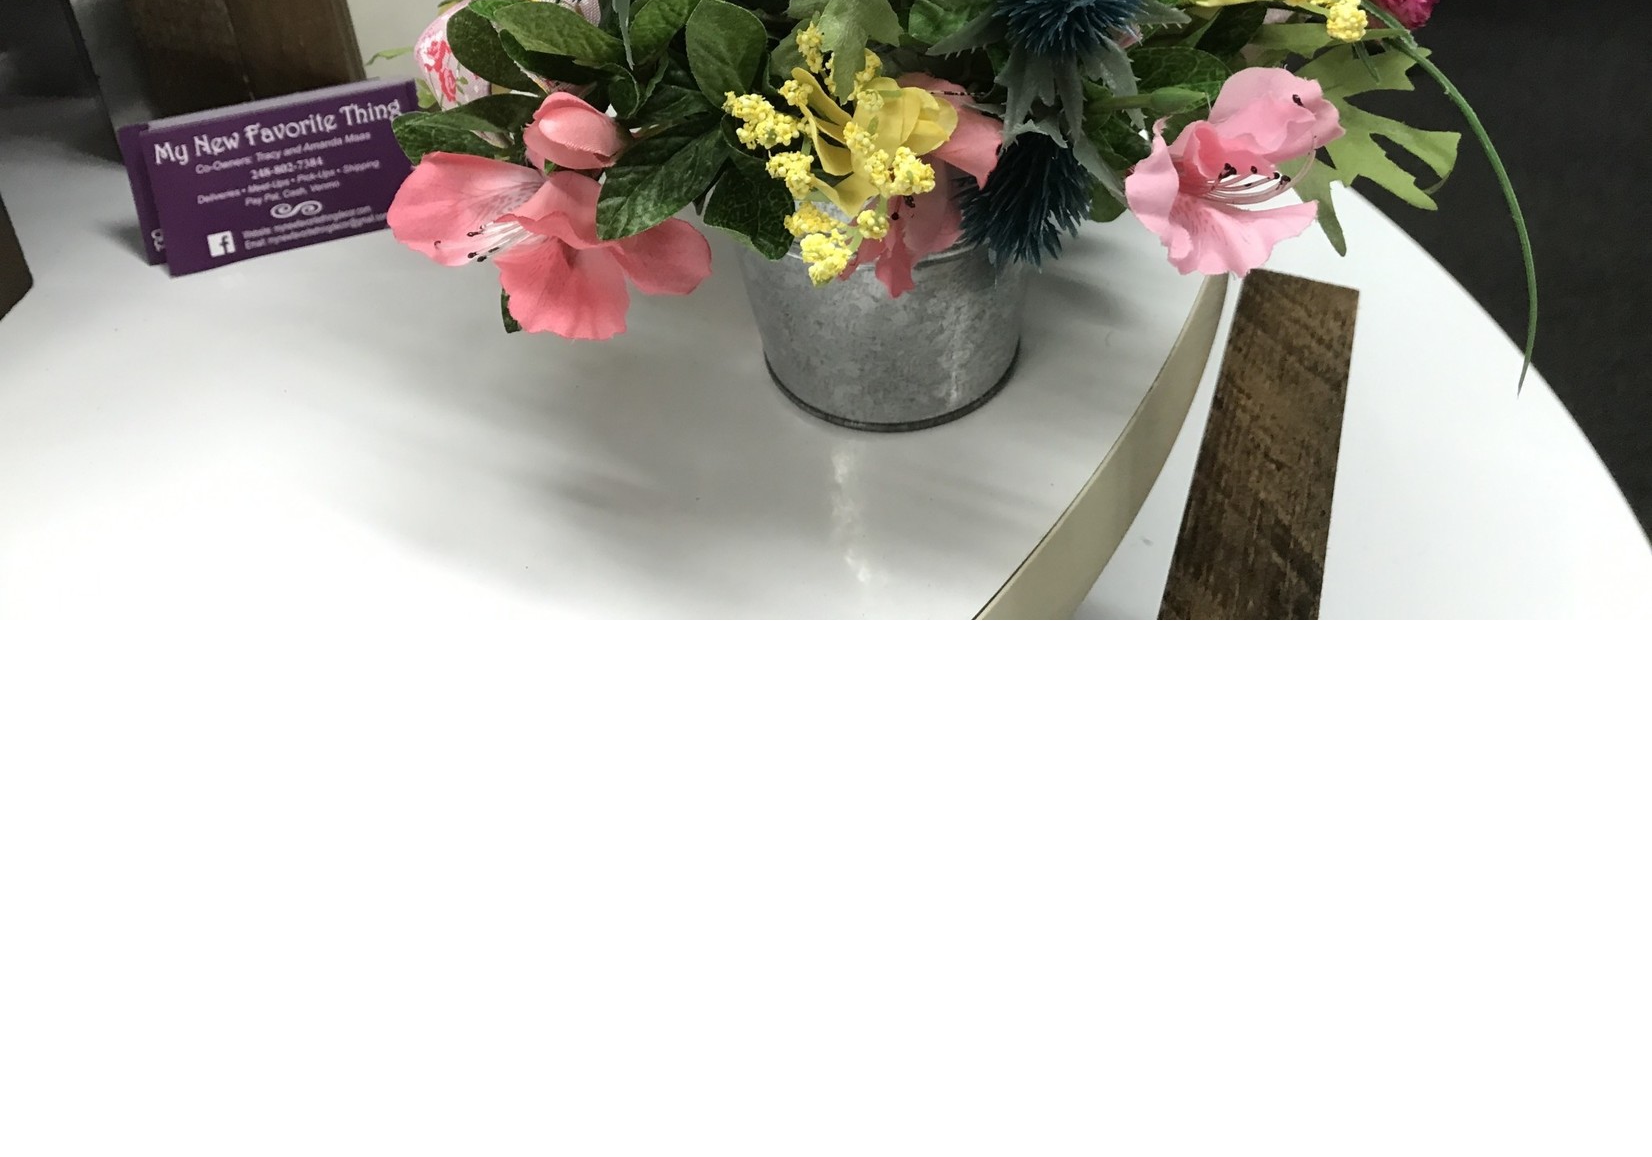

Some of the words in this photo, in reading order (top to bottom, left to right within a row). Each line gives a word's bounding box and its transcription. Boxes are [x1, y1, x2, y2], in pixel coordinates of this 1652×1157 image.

[154, 141, 189, 166] My
[193, 131, 240, 157] New
[243, 112, 337, 147] Favorite
[339, 98, 401, 127] Thing
[195, 156, 253, 175] Co-Owners:
[255, 150, 282, 162] Tracy
[283, 144, 302, 156] and
[303, 136, 343, 152] Amanda
[197, 188, 241, 205] Deliveries
[296, 168, 336, 184] Pick-Ups
[343, 159, 380, 174] Shipping
[244, 196, 263, 207] Pay
[309, 179, 340, 193] Venmo
